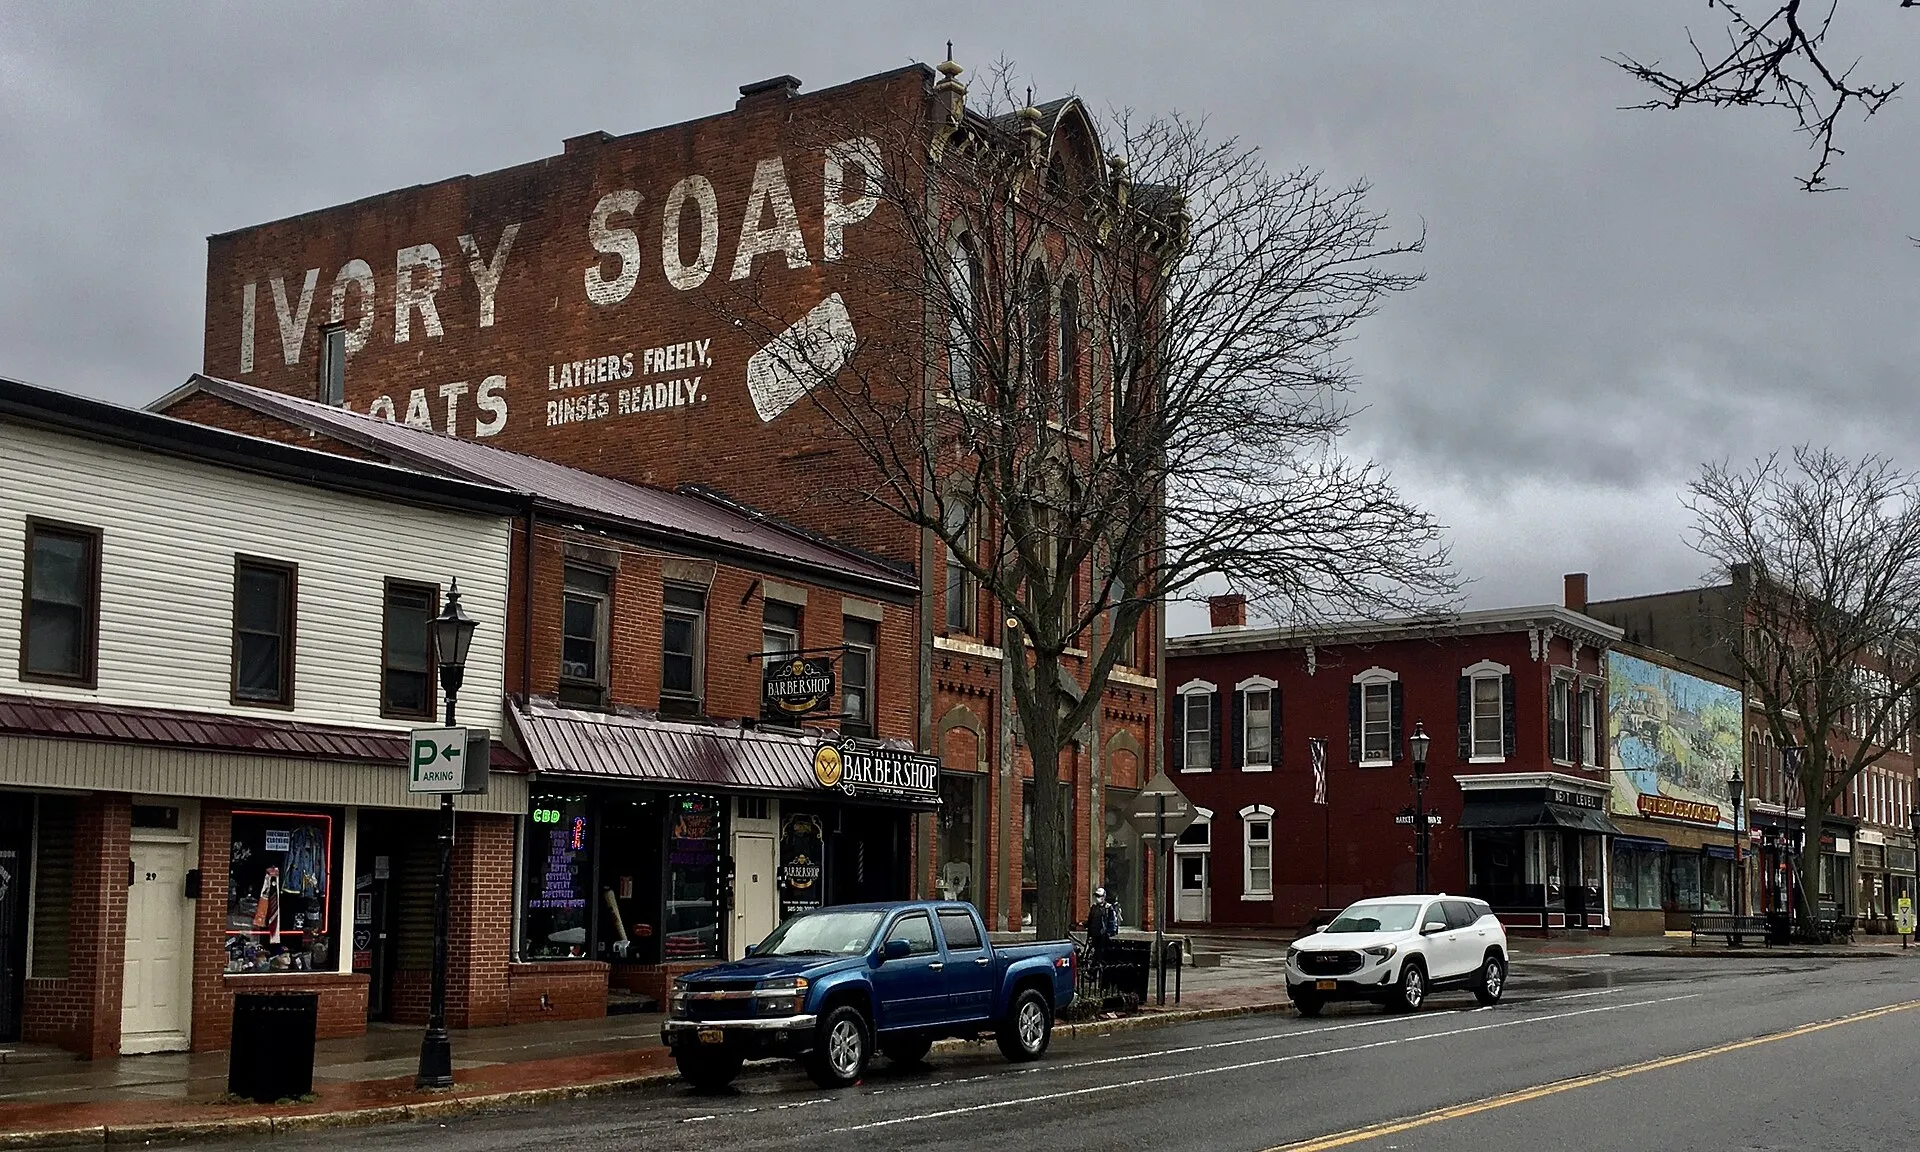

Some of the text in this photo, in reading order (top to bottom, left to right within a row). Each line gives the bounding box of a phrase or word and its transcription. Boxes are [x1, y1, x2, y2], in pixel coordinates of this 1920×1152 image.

[240, 136, 883, 374] IVORY SOAP
[548, 338, 712, 391] LATHERS FREELY,
[344, 374, 509, 438] OATS
[546, 376, 708, 426] RINSES READILY.
[767, 678, 830, 696] BARBERSHOP
[843, 755, 938, 790] BARBERSHOP
[1576, 794, 1596, 808] LEVEL
[533, 809, 560, 823] CBD
[574, 819, 583, 848] OPEN
[145, 872, 158, 881] 29
[545, 873, 572, 881] CRYSTALS
[546, 881, 570, 890] JEWELRY
